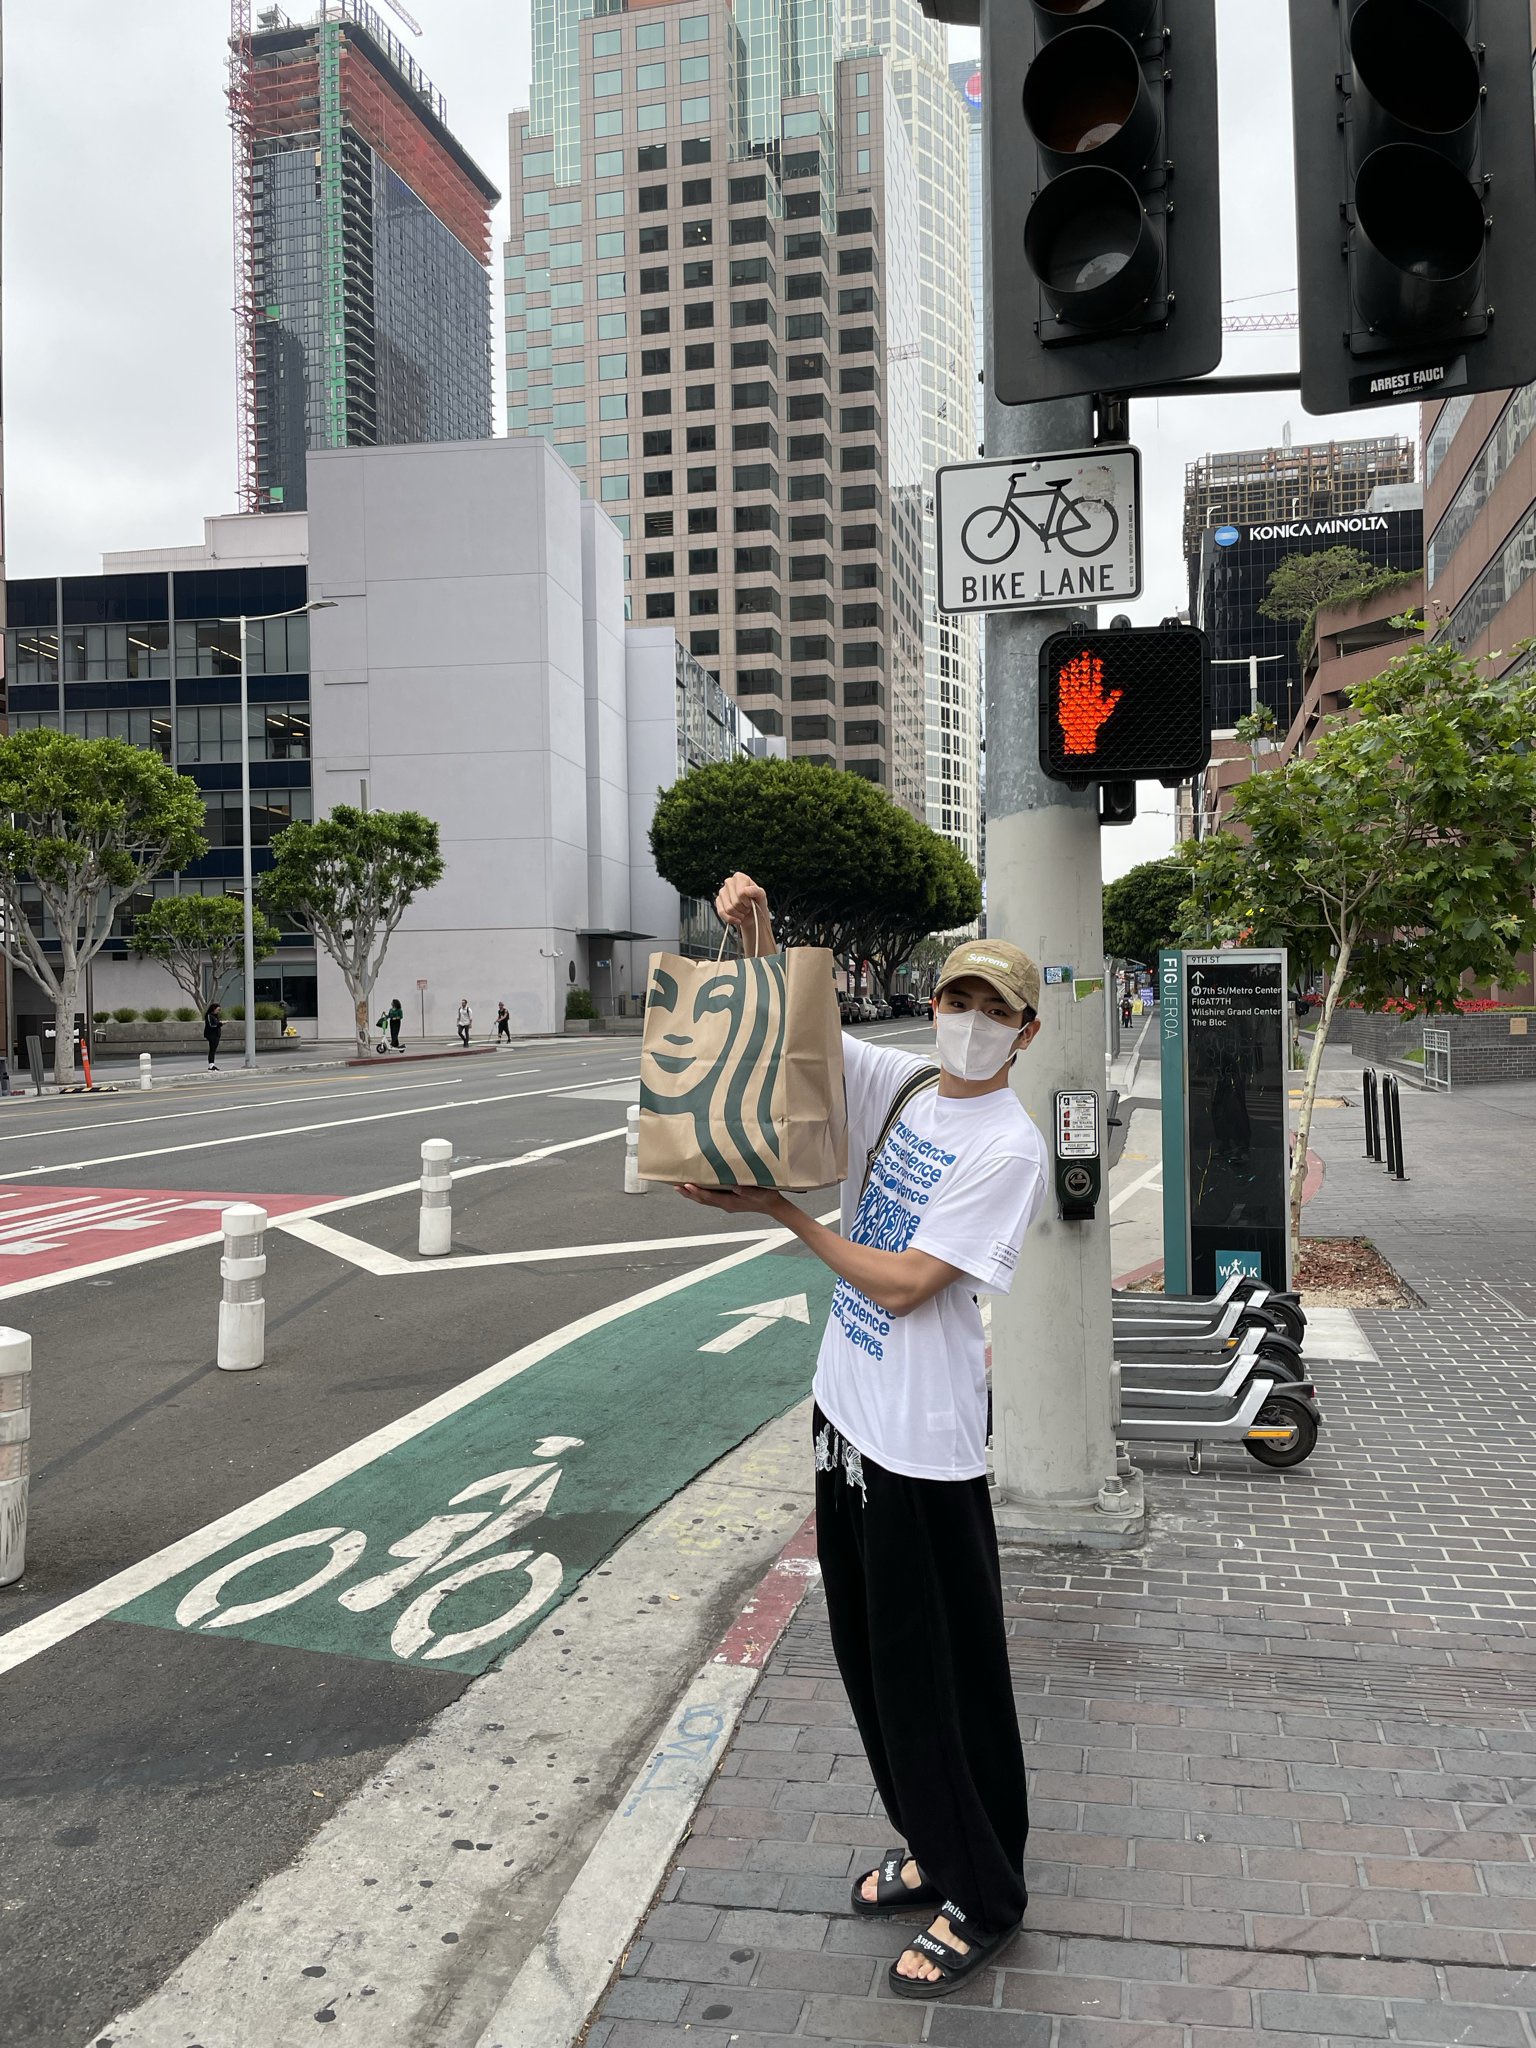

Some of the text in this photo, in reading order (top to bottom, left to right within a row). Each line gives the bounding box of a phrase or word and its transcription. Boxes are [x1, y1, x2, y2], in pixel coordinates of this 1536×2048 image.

[1370, 366, 1444, 393] ARREST FAUCI
[1250, 516, 1388, 541] KONICA MINOLTA
[962, 571, 1025, 603] BIKE
[1040, 564, 1114, 597] LANE
[967, 953, 1009, 969] Supreme
[1191, 956, 1221, 964] 9TH ST
[1163, 957, 1179, 1040] FIGUEROA
[1202, 987, 1216, 995] 7th
[1217, 986, 1253, 995] St/Metro
[1255, 986, 1282, 995] Center
[1191, 997, 1232, 1006] FIGAT7TH
[1191, 1007, 1282, 1016] Wilshire Grand Center
[1191, 1018, 1227, 1027] The Bloc
[913, 1934, 946, 1956] Angels
